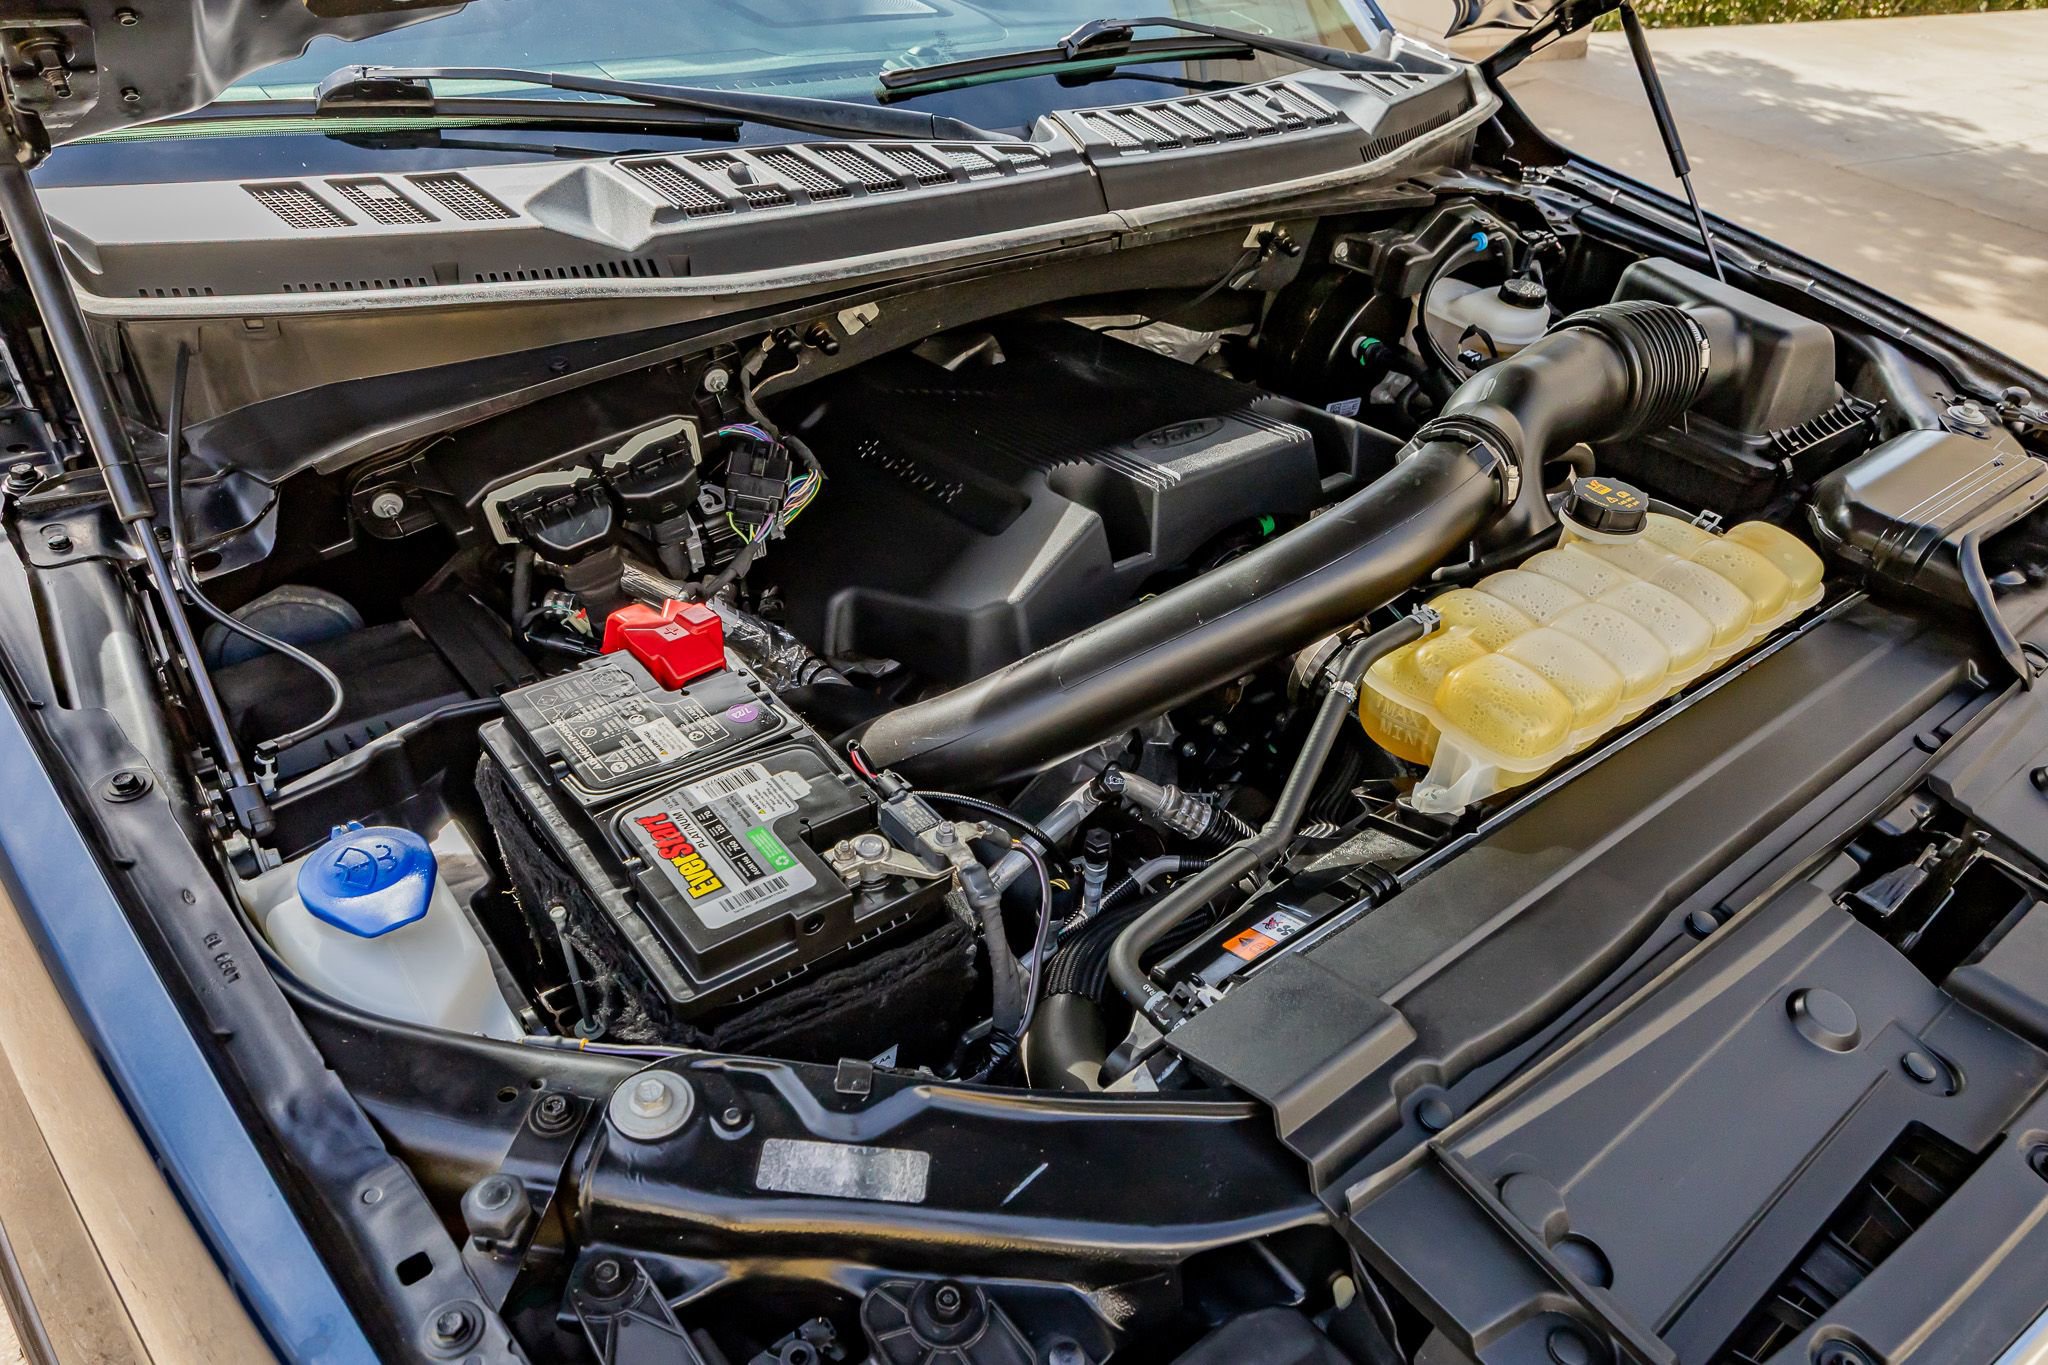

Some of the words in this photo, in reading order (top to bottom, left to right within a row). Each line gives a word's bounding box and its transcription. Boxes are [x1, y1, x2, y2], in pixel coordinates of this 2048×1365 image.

[1383, 700, 1420, 728] MAX
[1379, 718, 1418, 746] MIN
[672, 812, 708, 849] PLATINUM
[714, 823, 726, 834] 120
[632, 811, 725, 900] EverStart
[728, 839, 741, 851] 760
[746, 861, 761, 875] AGM
